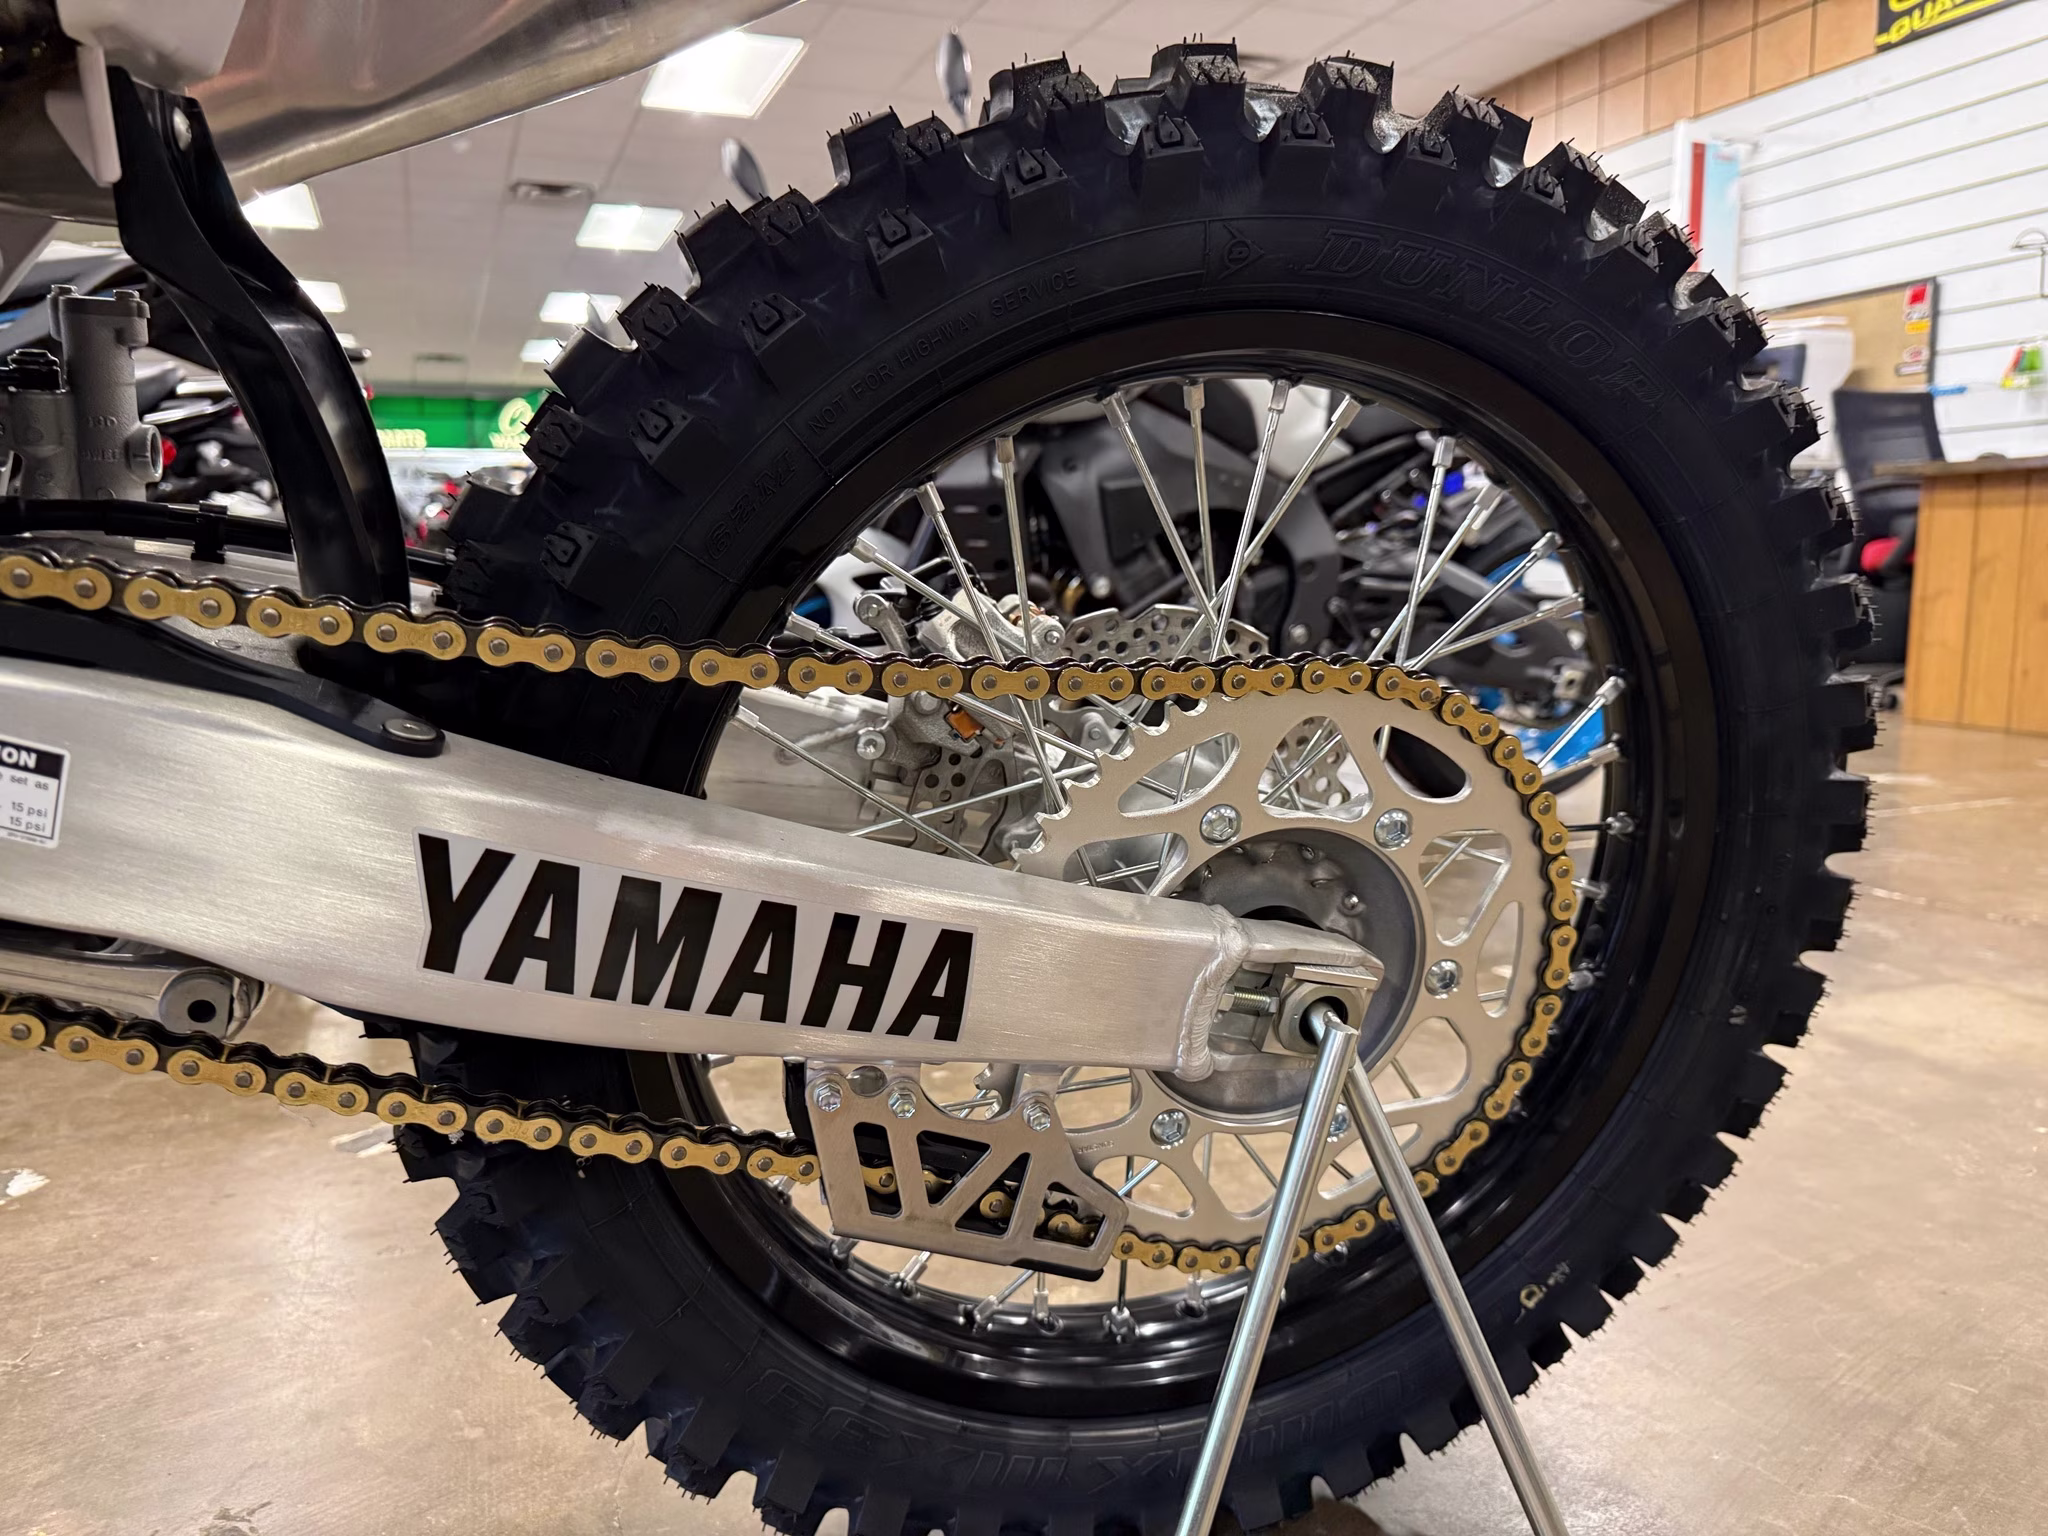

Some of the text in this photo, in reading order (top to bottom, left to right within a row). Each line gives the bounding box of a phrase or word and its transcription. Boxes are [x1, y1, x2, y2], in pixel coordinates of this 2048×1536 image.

[807, 266, 1080, 435] NOT FOR HIGHWAY SERVICE
[1305, 229, 1668, 405] DUNLOP
[0, 744, 37, 770] ON
[9, 815, 46, 833] 15 psi
[11, 800, 48, 818] 15 psi
[418, 833, 974, 1042] YAMAHA
